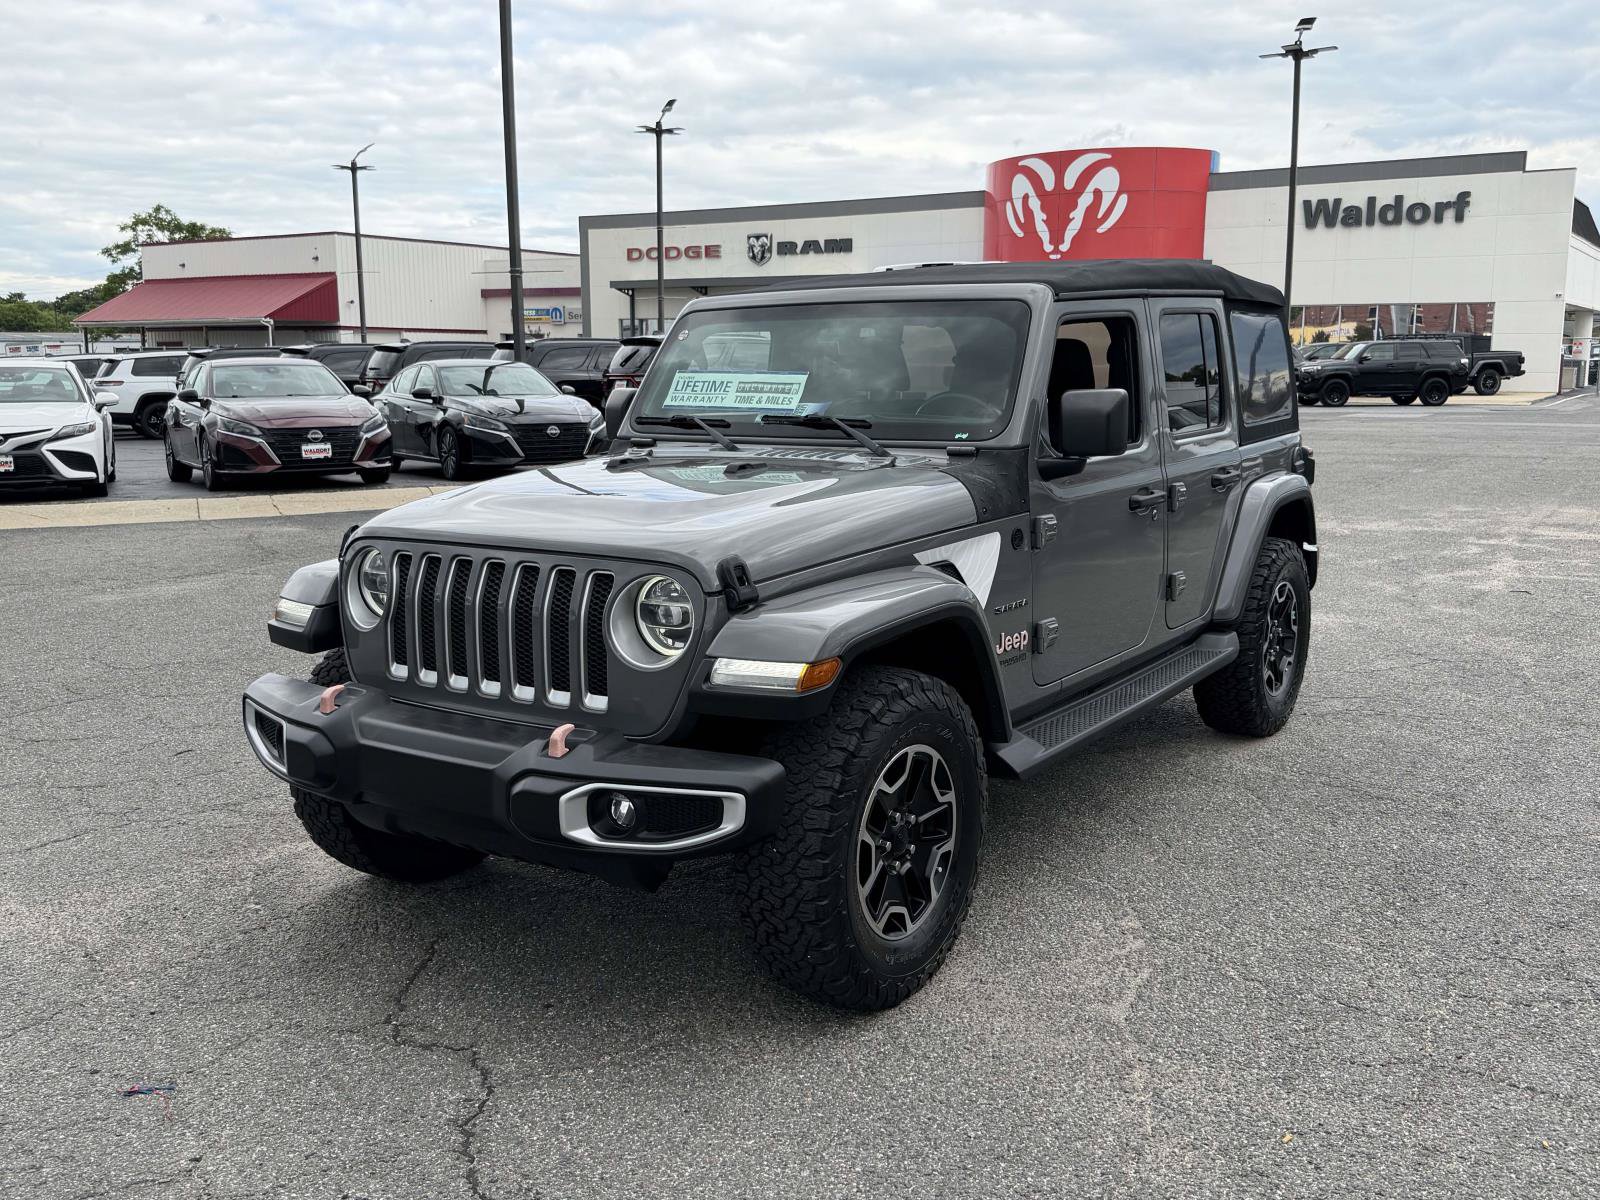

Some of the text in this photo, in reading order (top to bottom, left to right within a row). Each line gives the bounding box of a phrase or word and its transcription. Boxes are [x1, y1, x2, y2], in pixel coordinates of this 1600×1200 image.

[1303, 190, 1472, 229] Waldorf
[626, 244, 721, 262] DODGE
[776, 238, 853, 256] RAM
[674, 380, 733, 393] LIFETIME
[671, 395, 726, 404] WARRANTY
[734, 395, 793, 406] TIME & MILES
[995, 630, 1029, 655] Jeep
